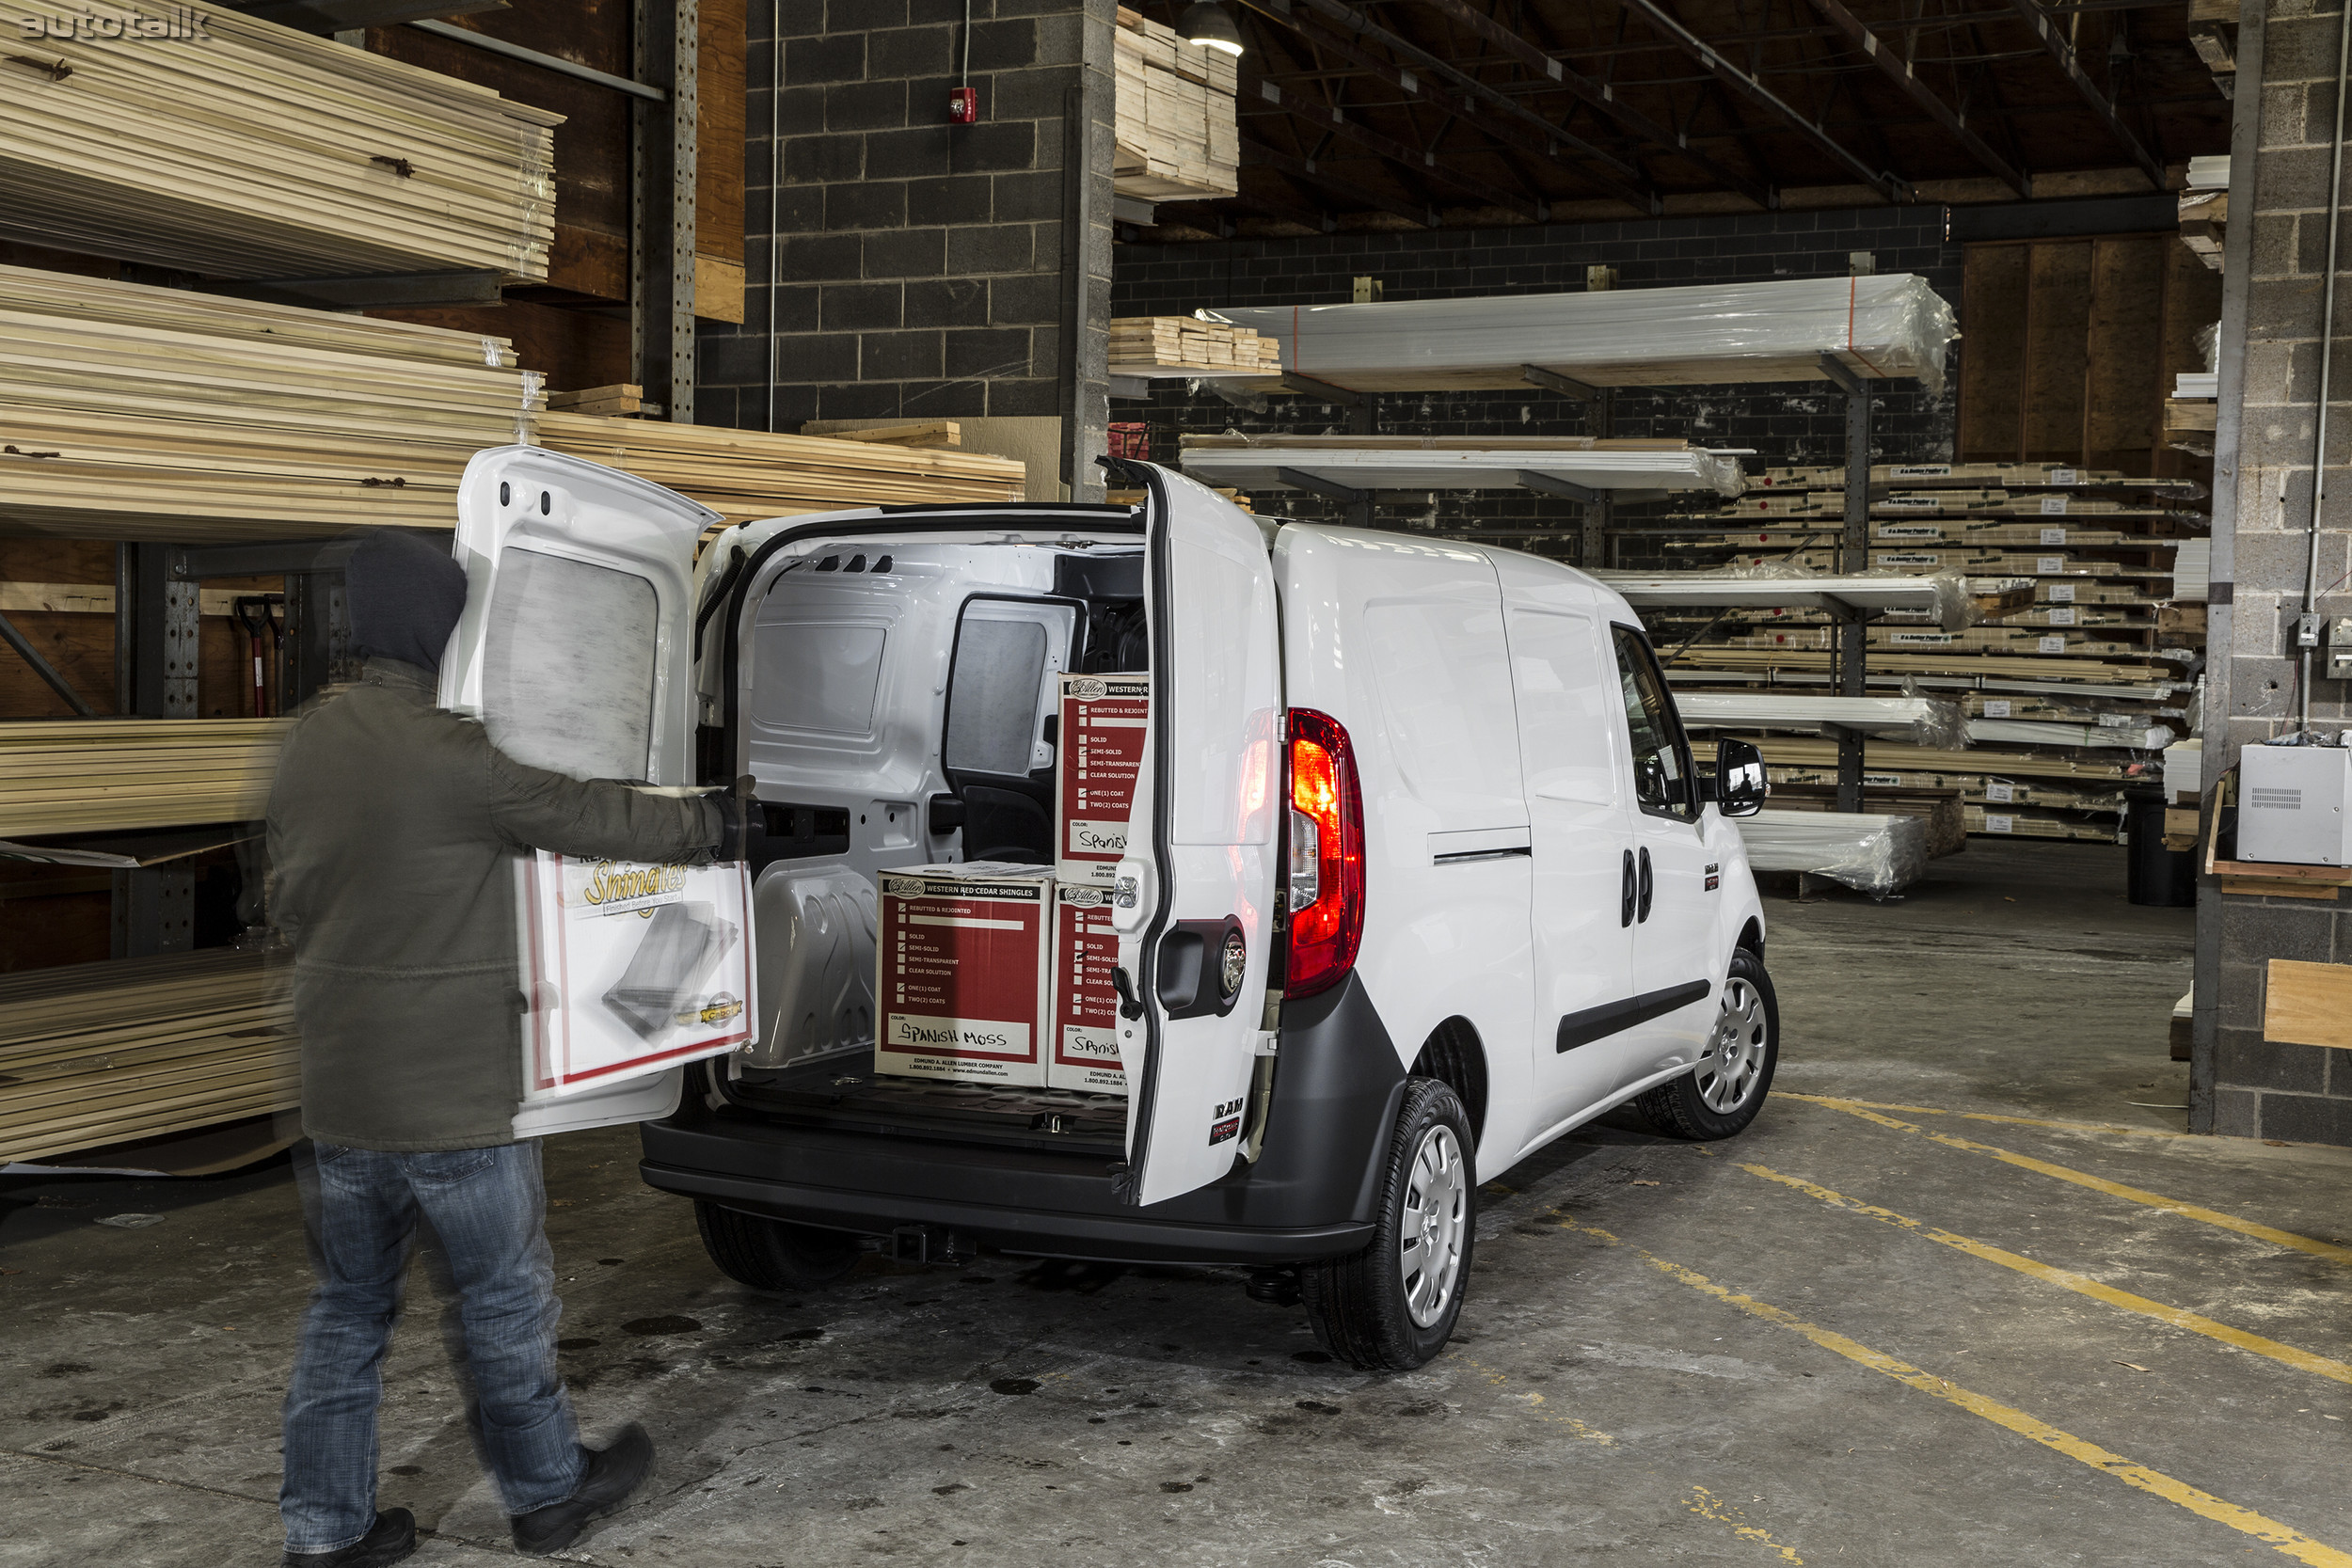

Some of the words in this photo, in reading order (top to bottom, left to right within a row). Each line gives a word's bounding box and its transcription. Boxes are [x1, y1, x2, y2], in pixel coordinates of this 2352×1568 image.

[584, 861, 687, 918] Shingles
[606, 903, 631, 912] Finished
[632, 900, 651, 908] Before
[909, 956, 959, 965] SEMI-TRANSPARENT
[898, 1023, 959, 1043] SPANISH
[964, 1032, 1007, 1046] MOSS
[952, 1068, 1008, 1077] www.edmundallen.com
[1213, 1098, 1243, 1120] RAM
